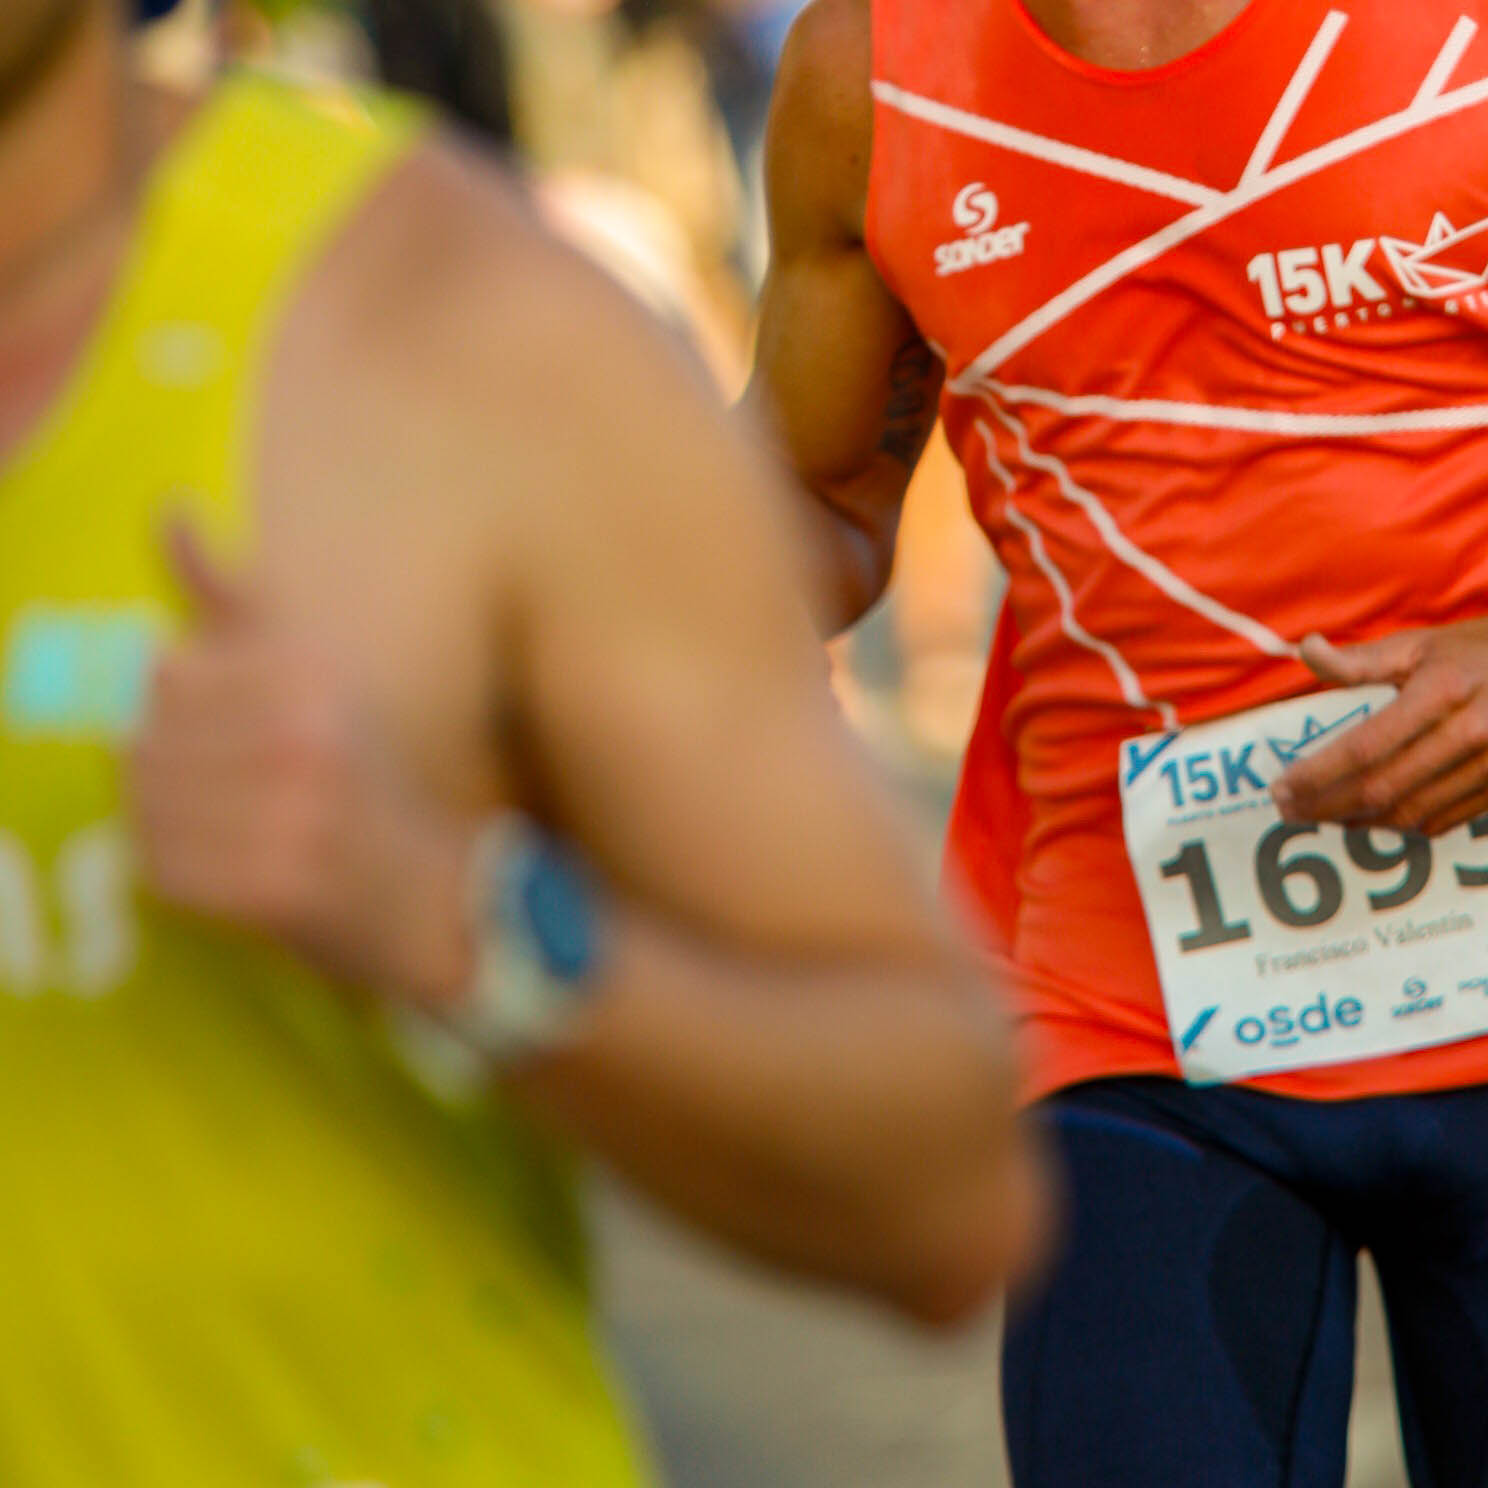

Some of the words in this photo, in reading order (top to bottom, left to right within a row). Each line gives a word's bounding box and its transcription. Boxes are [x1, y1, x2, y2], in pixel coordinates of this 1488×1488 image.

[1246, 237, 1385, 319] 15K
[1159, 740, 1268, 807] 15K
[1234, 991, 1365, 1046] osde
